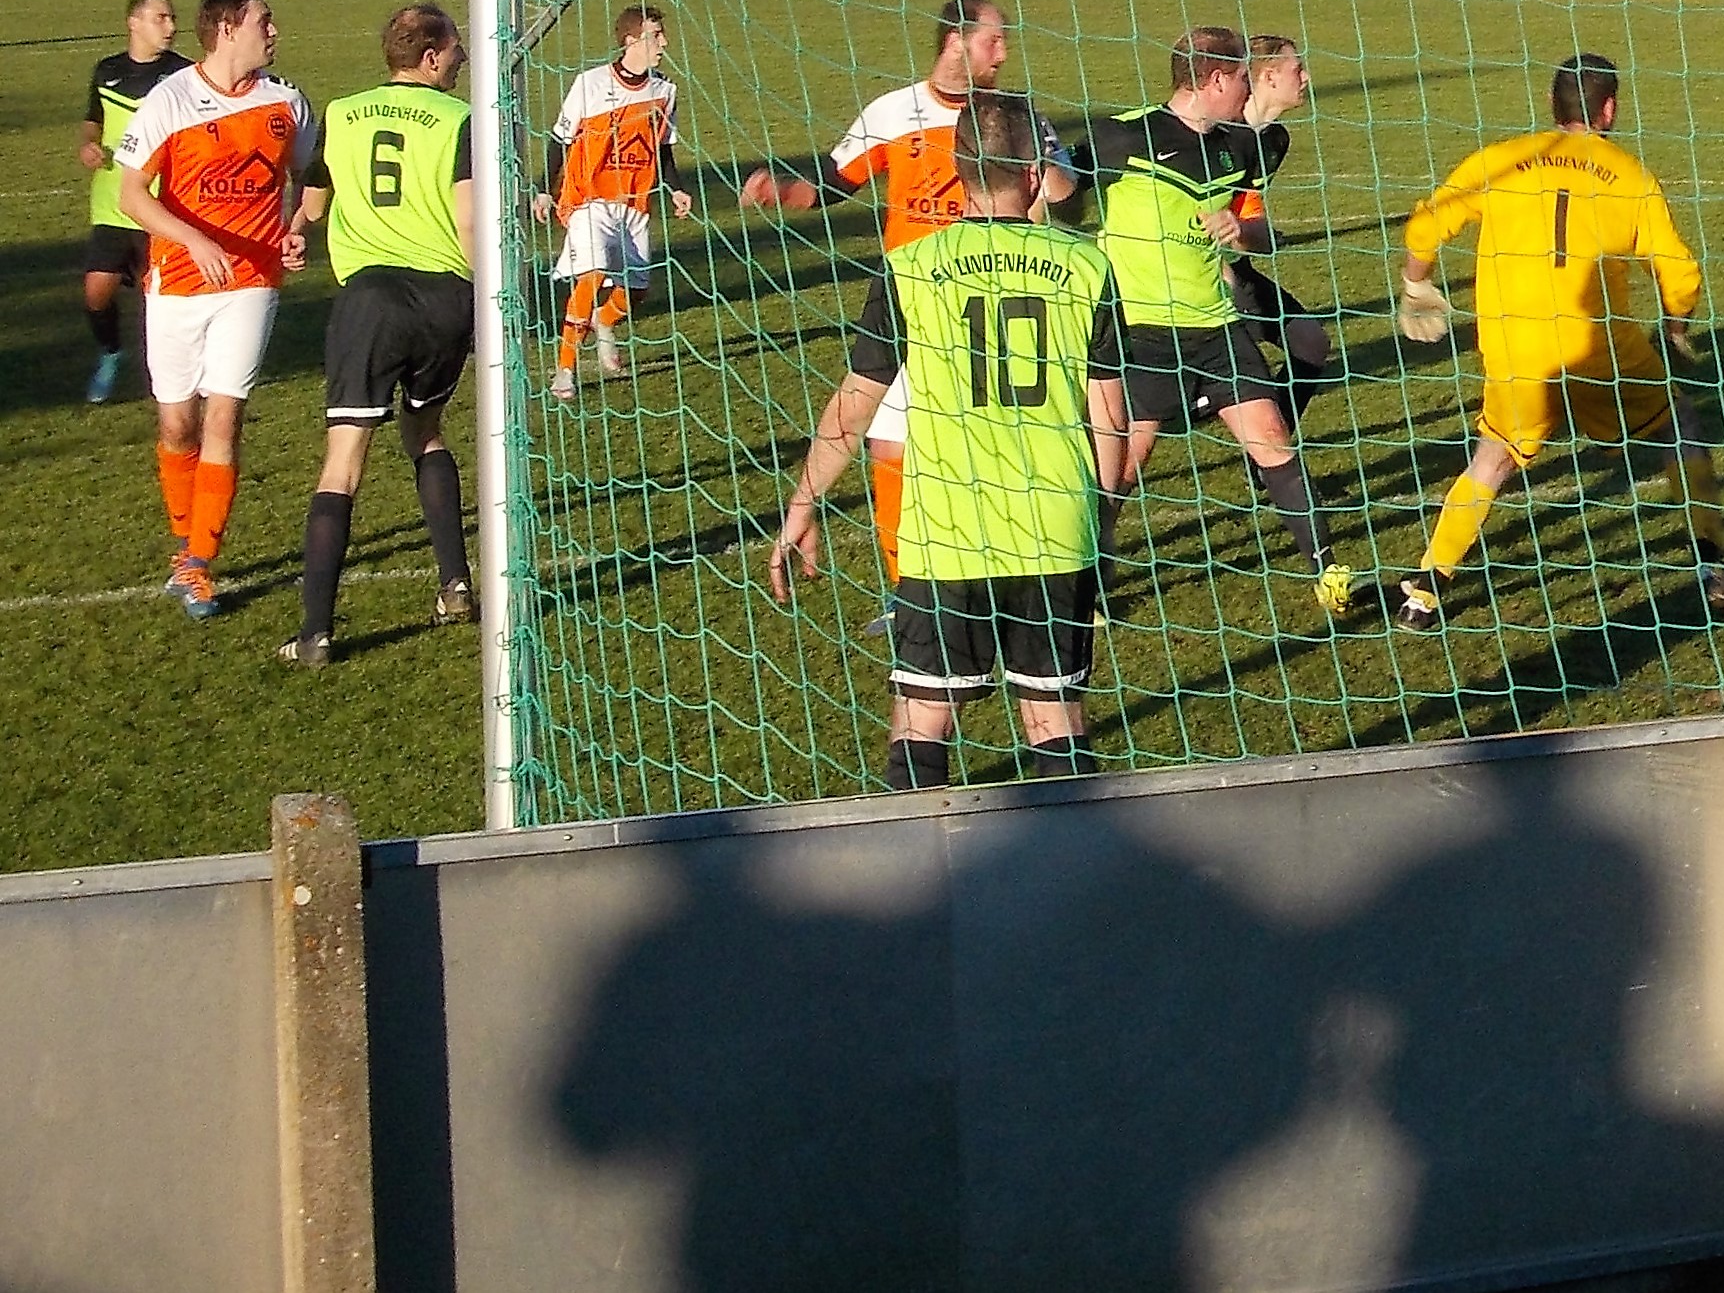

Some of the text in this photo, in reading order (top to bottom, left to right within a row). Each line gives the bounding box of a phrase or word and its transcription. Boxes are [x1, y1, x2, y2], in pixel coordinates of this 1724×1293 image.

[206, 122, 220, 142] 9
[346, 104, 441, 129] SV LINDENHARDT
[200, 178, 256, 194] KOLB
[370, 130, 405, 207] 6
[1554, 188, 1570, 268] 1
[955, 253, 1074, 288] LINDENHARDT
[961, 296, 1048, 408] 10
